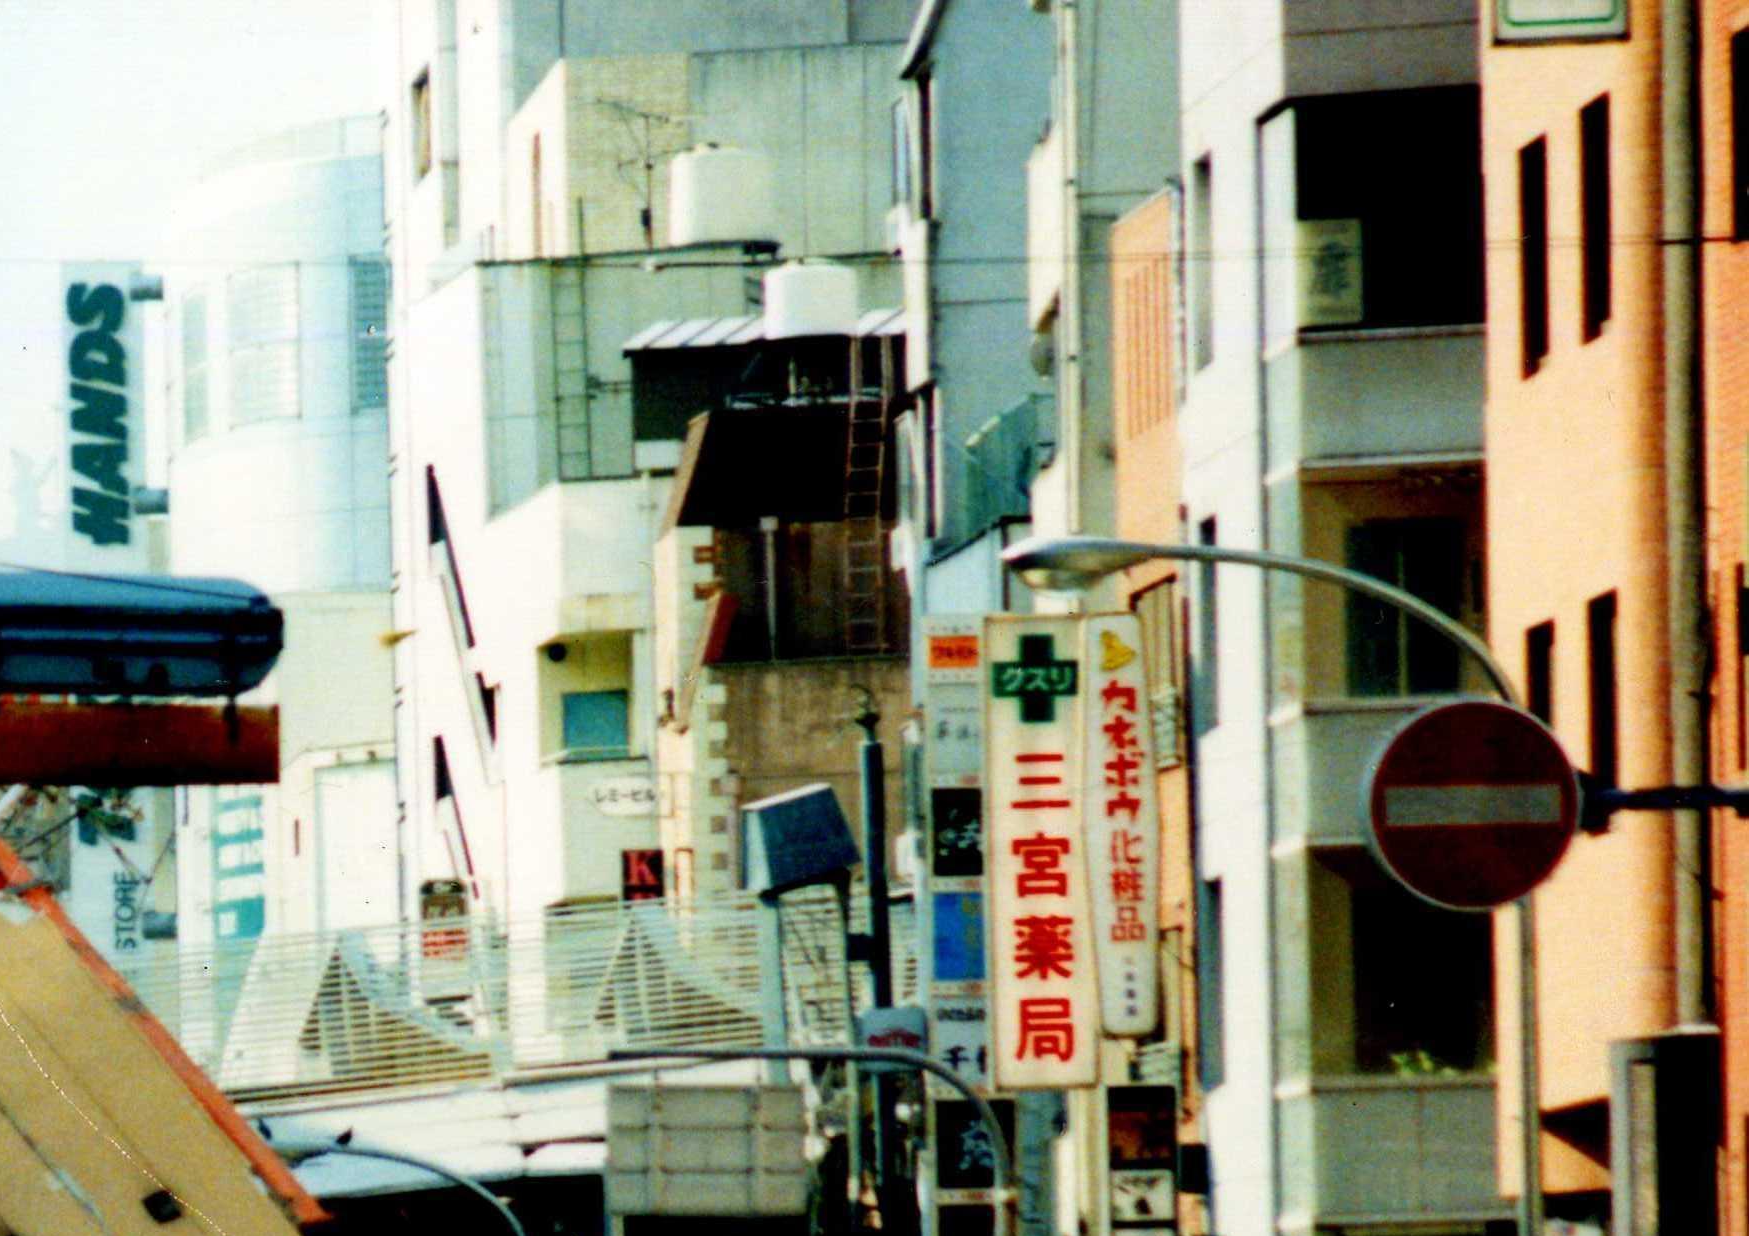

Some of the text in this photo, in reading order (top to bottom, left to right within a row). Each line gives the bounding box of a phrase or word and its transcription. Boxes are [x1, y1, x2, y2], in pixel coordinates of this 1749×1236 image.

[67, 281, 131, 547] HANDS
[997, 665, 1074, 693] クスリ
[113, 871, 139, 952] STORE
[1009, 752, 1076, 1064] 三宮薬局
